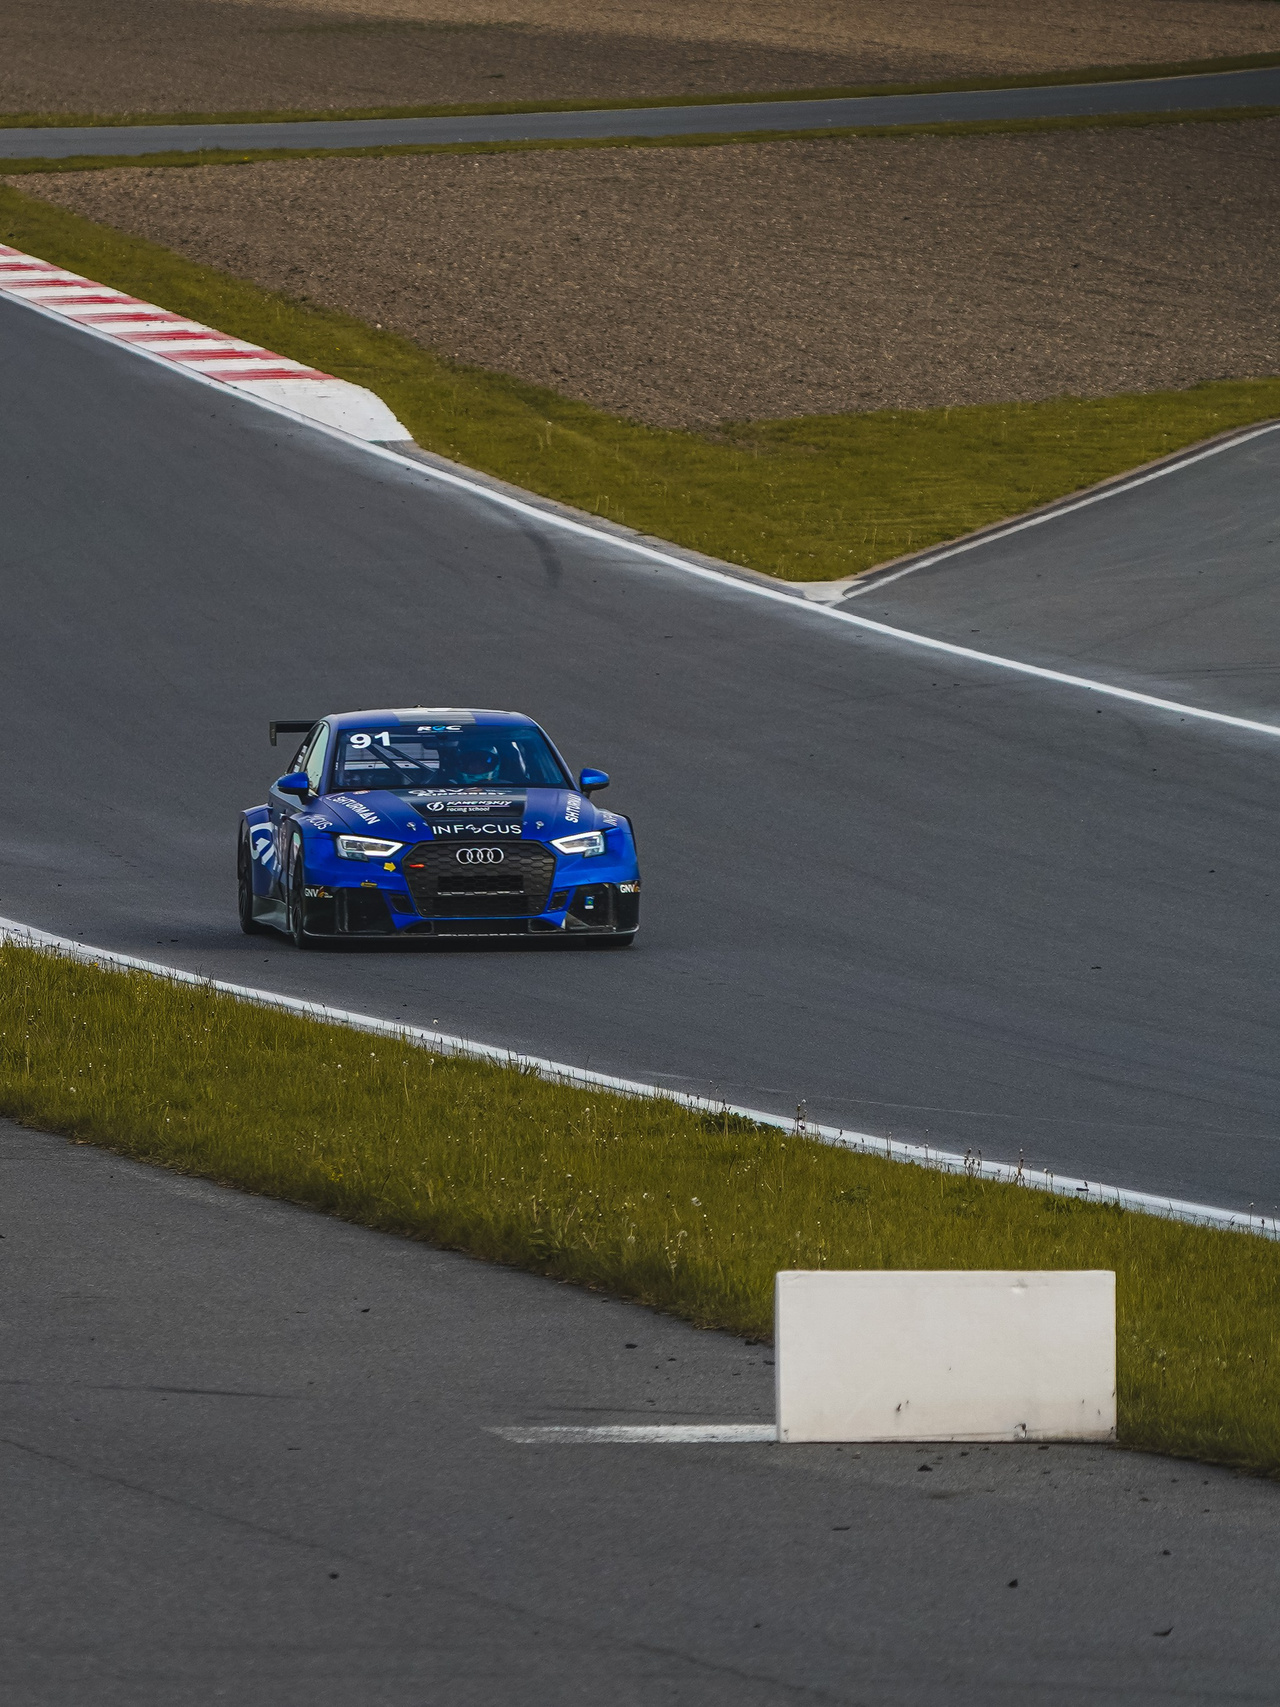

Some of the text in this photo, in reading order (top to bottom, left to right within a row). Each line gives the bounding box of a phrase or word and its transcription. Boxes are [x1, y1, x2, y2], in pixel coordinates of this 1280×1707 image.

[349, 731, 391, 749] 91
[332, 796, 381, 825] SHTURMAN
[304, 887, 319, 898] GNV
[620, 884, 635, 893] GNV
